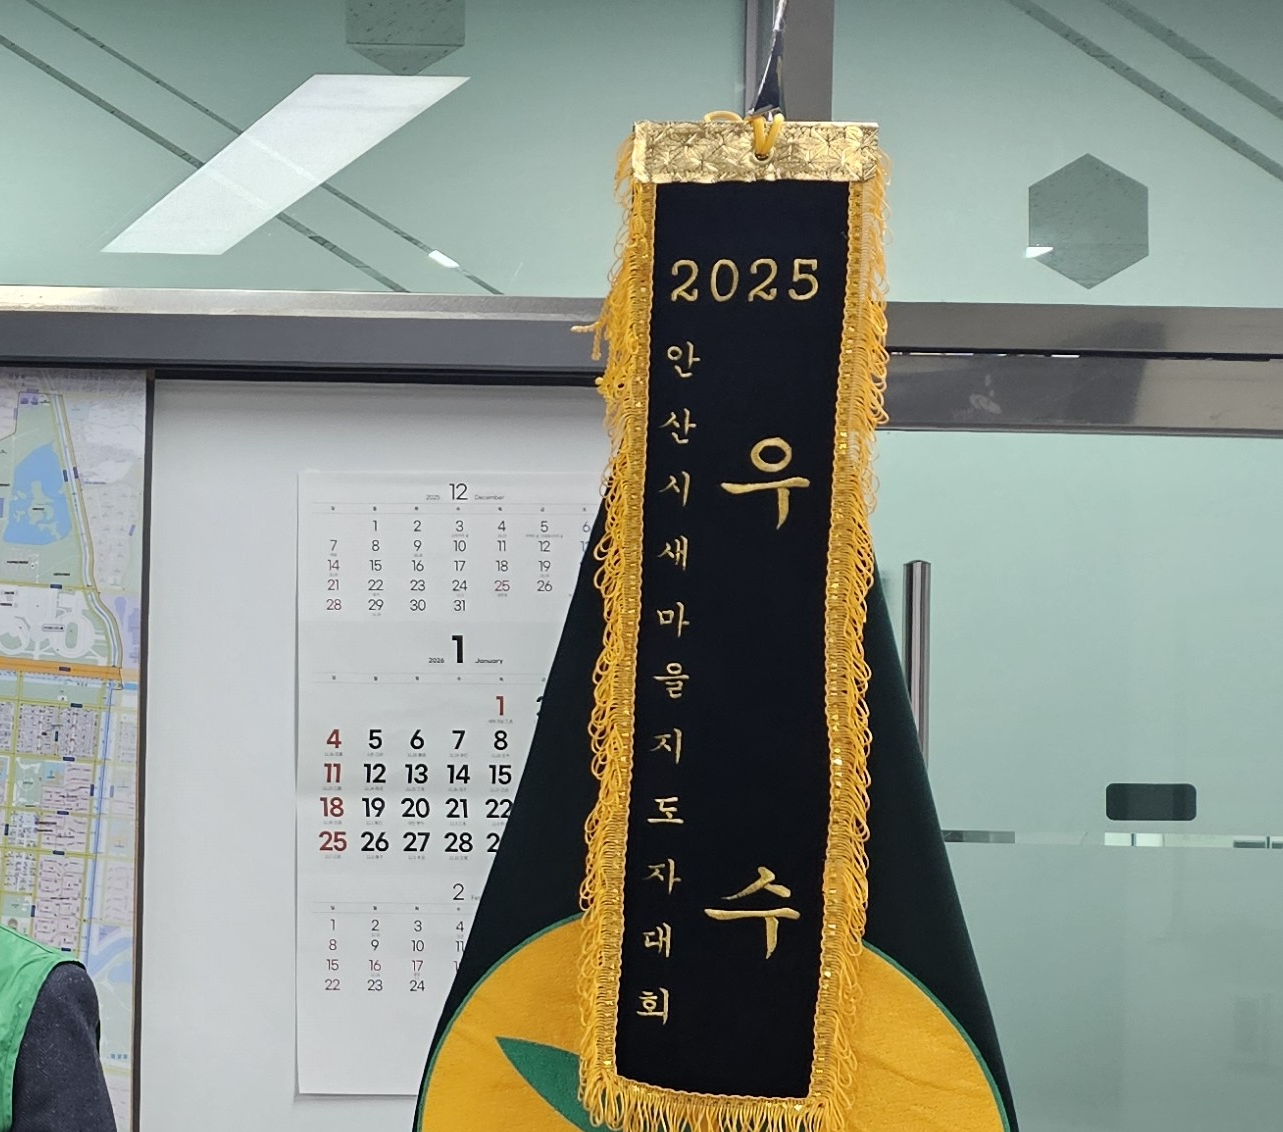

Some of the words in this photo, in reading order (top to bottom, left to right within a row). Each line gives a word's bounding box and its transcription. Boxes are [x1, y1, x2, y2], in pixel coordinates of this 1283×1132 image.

[671, 258, 820, 302] 2025
[449, 483, 467, 500] 12
[373, 520, 378, 532] 1
[414, 520, 421, 532] 2
[456, 521, 463, 532] 3
[498, 521, 505, 531] 4
[541, 521, 548, 532] 5
[330, 540, 337, 551] 7
[372, 540, 379, 551] 8
[414, 540, 421, 551] 9
[454, 540, 466, 551] 10
[498, 540, 506, 551] 11
[538, 541, 550, 552] 12
[328, 560, 339, 570] 14
[370, 560, 382, 571] 15
[412, 560, 424, 571] 16
[454, 561, 465, 571] 17
[496, 560, 508, 572] 18
[539, 561, 550, 571] 19
[328, 579, 338, 590] 21
[368, 579, 383, 590] 22
[410, 580, 425, 591] 23
[452, 580, 467, 591] 24
[495, 580, 510, 591] 25
[537, 580, 552, 591] 26
[327, 599, 341, 610] 28
[369, 599, 383, 610] 29
[410, 599, 426, 611] 30
[454, 600, 465, 611] 31
[452, 636, 463, 663] 1
[496, 696, 503, 715] 1
[327, 729, 341, 748] 4
[369, 730, 382, 749] 5
[410, 730, 424, 749] 6
[453, 730, 465, 749] 7
[494, 730, 507, 750] 8
[324, 763, 340, 783] 11
[364, 764, 386, 783] 12
[405, 764, 428, 783] 13
[447, 765, 470, 783] 14
[489, 765, 511, 784] 15
[320, 797, 343, 817] 18
[362, 798, 385, 817] 19
[401, 798, 430, 818] 20
[446, 798, 467, 818] 21
[486, 798, 513, 818] 22
[319, 831, 346, 851] 25
[361, 832, 388, 851] 26
[403, 832, 430, 851] 27
[444, 833, 473, 852] 28
[487, 833, 500, 853] 2
[453, 884, 464, 900] 2
[331, 919, 335, 930] 1
[372, 920, 379, 931] 2
[414, 920, 422, 932] 3
[456, 921, 463, 931] 4
[329, 939, 337, 950] 8
[371, 940, 379, 950] 9
[412, 940, 424, 951] 10
[456, 940, 464, 952] 11
[327, 959, 339, 970] 15
[369, 960, 381, 971] 16
[412, 960, 423, 971] 17
[325, 979, 340, 990] 22
[368, 980, 382, 991] 23
[410, 980, 424, 991] 24
